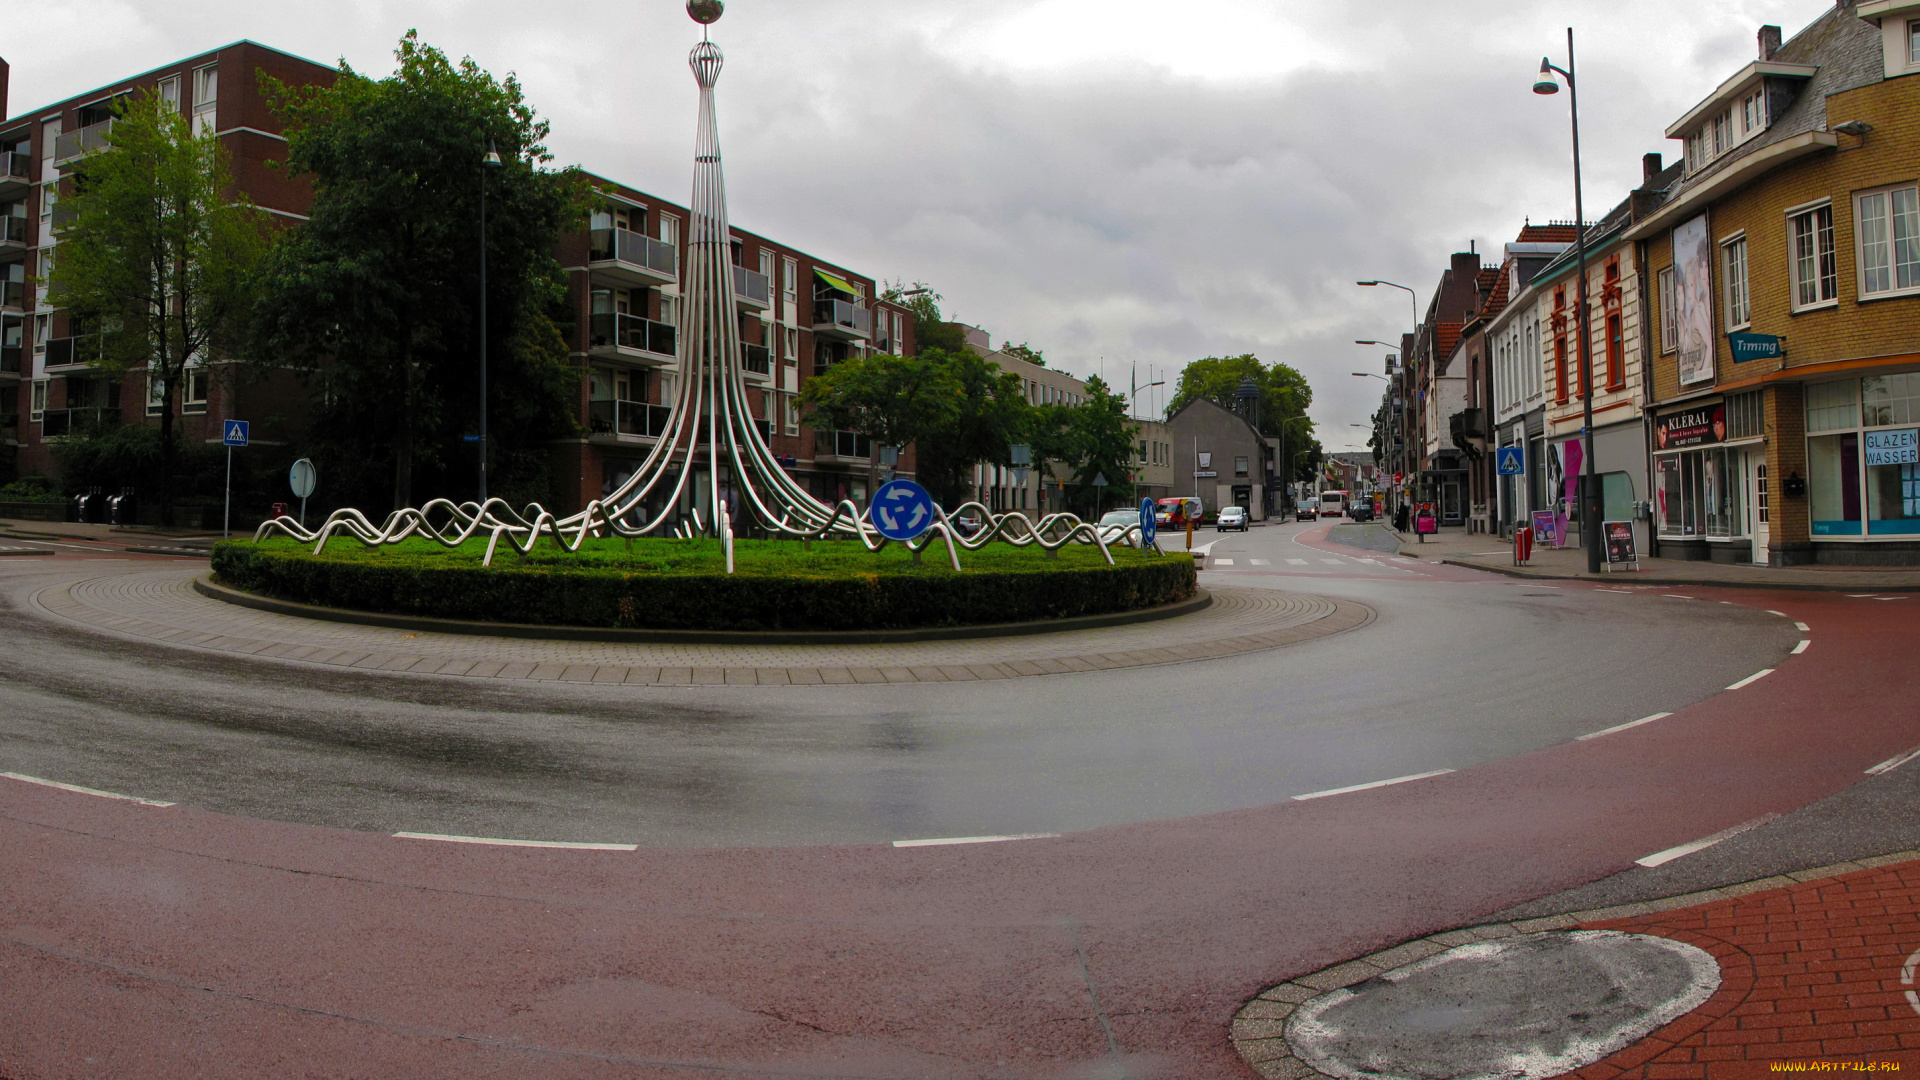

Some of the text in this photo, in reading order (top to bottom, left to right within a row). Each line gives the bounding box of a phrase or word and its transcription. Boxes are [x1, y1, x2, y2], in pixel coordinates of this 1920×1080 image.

[1737, 340, 1777, 354] Timing
[1668, 411, 1709, 430] KLÉRAL
[1866, 433, 1917, 448] GLAZEN
[1866, 450, 1917, 464] WASSER
